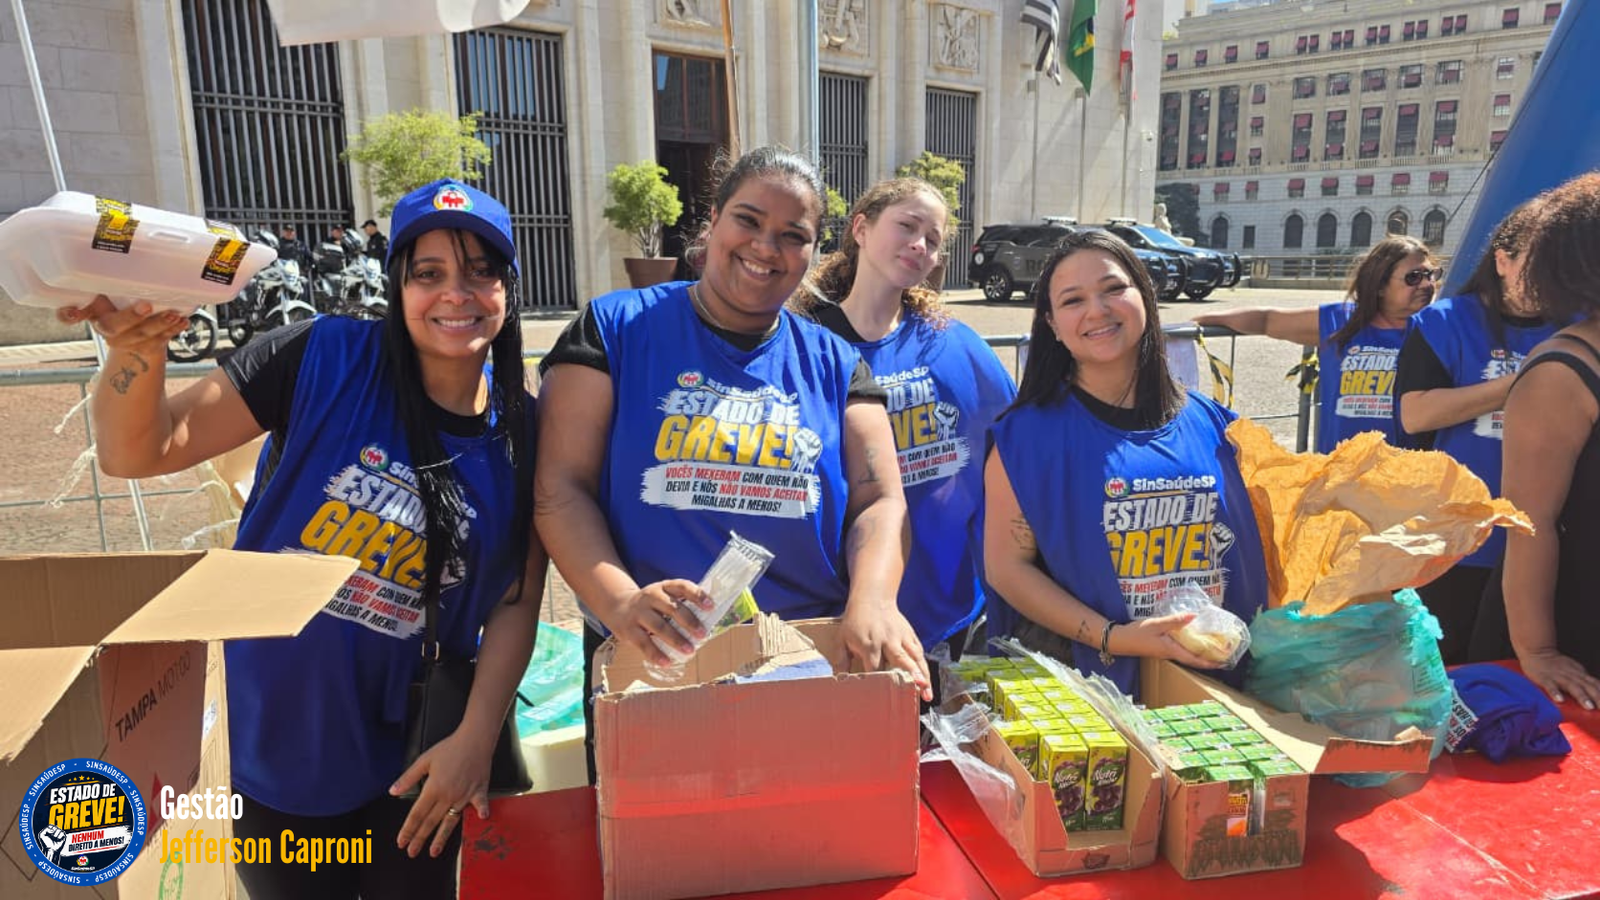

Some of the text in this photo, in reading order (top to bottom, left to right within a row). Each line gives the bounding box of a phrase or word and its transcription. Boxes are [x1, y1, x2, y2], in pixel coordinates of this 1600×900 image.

[1341, 355, 1396, 371] ESTADO
[1340, 371, 1397, 395] GREV
[667, 390, 800, 426] ESTADO DE
[654, 414, 798, 470] GREVE!
[665, 465, 810, 490] VOCÊS MEXERAM COM QUEM NÃO
[1132, 475, 1216, 491] SinSaúdeSP
[692, 481, 700, 492] E
[700, 479, 719, 494] NÓS
[719, 483, 739, 496] NÃO
[739, 485, 771, 499] VAMOS
[773, 488, 809, 502] ACEITAR
[691, 494, 783, 513] MIGALHAS A MENOS!
[1103, 492, 1219, 531] ESTADO DE
[115, 688, 158, 743] TAMPA
